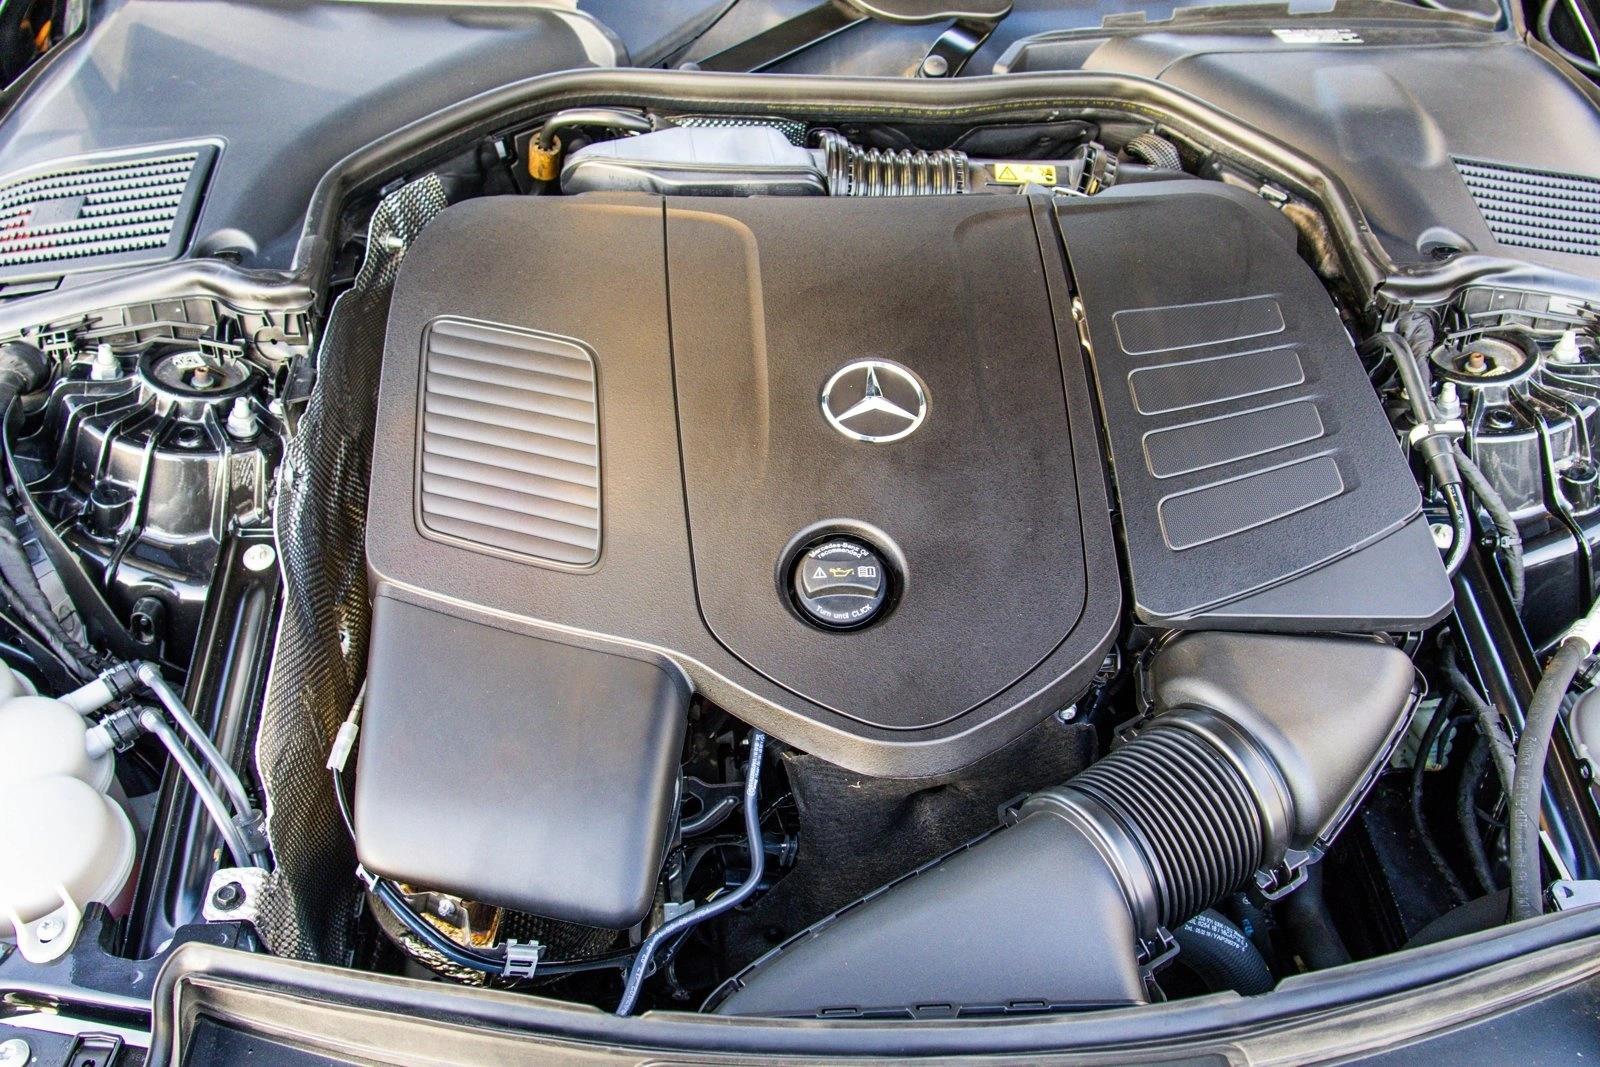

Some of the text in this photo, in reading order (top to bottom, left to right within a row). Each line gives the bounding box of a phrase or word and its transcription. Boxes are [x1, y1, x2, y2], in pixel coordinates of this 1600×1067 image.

[809, 543, 869, 558] Mercedes-Benz Oil
[818, 548, 862, 558] recommended
[816, 604, 872, 619] Turn until CLICK
